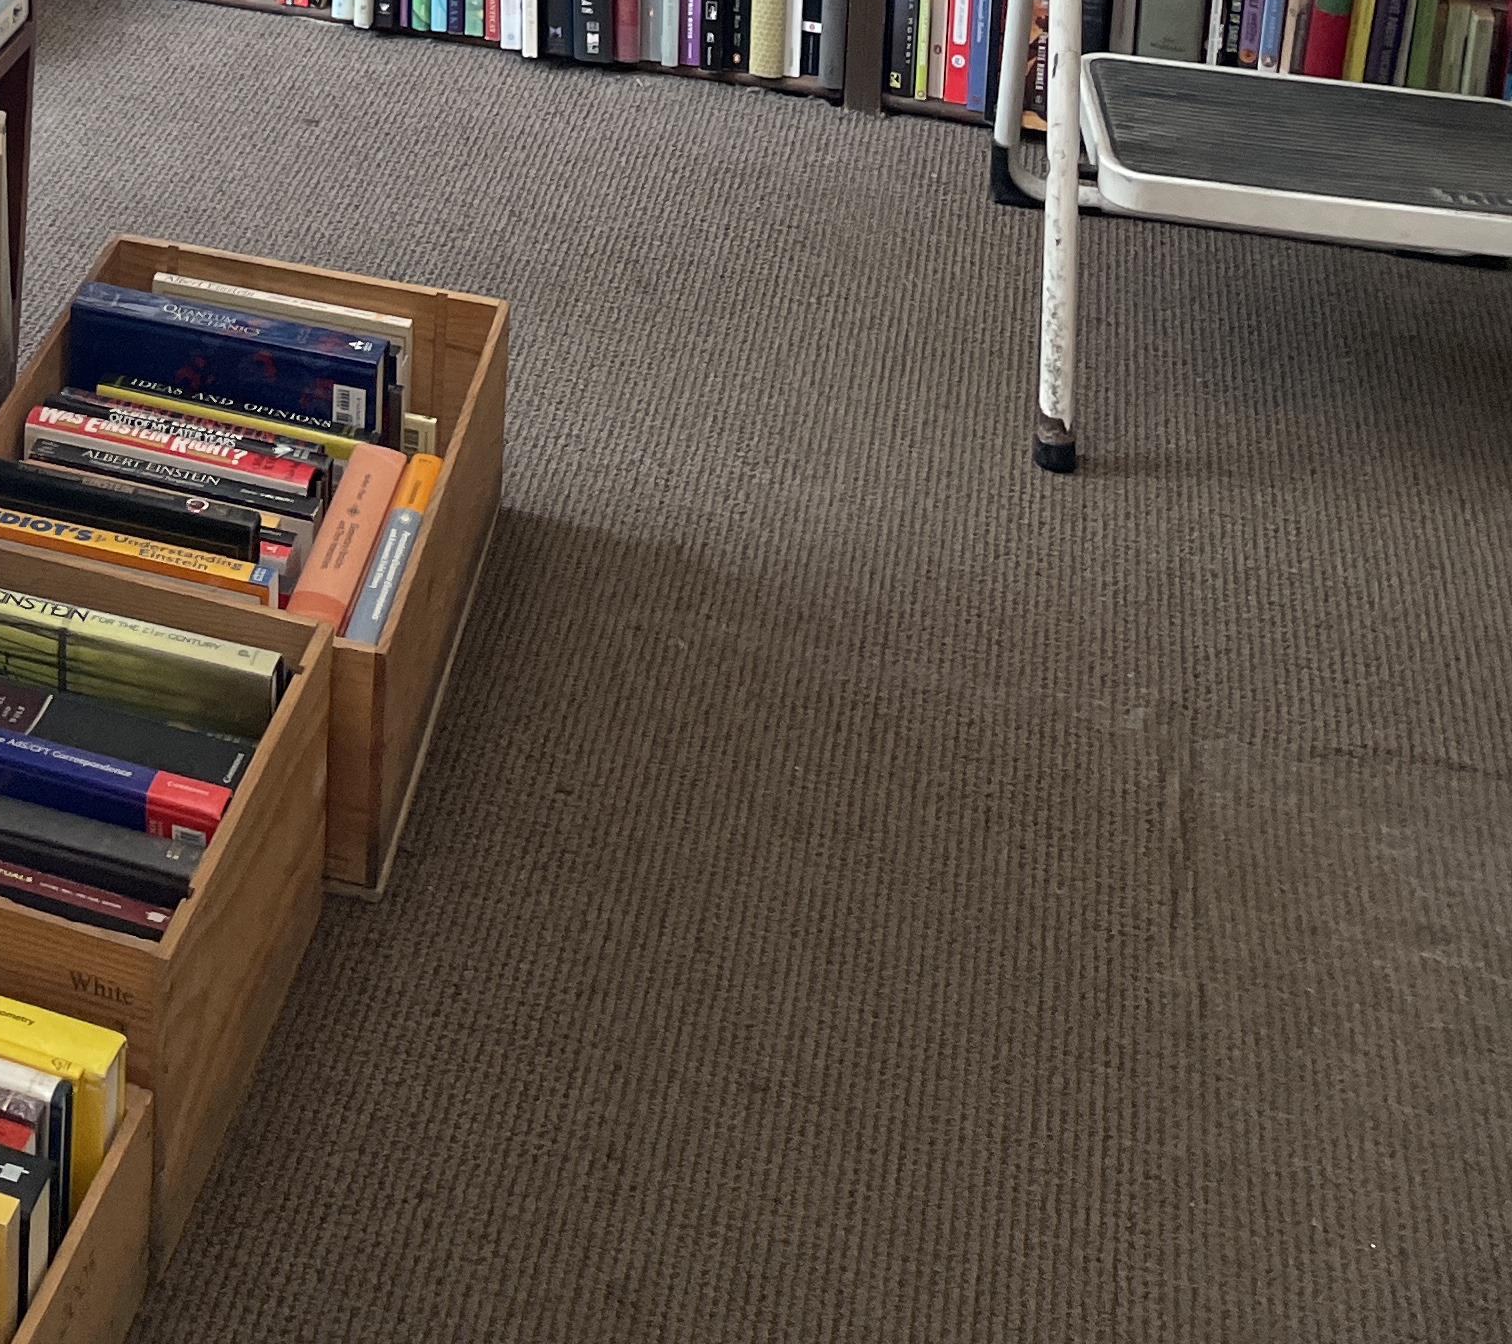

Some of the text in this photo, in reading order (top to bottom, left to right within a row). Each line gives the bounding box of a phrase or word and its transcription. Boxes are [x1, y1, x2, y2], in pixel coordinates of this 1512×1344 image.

[128, 376, 332, 430] IDEAS AND OPINIONS
[114, 533, 243, 572] Understanding
[138, 548, 208, 572] Einstein
